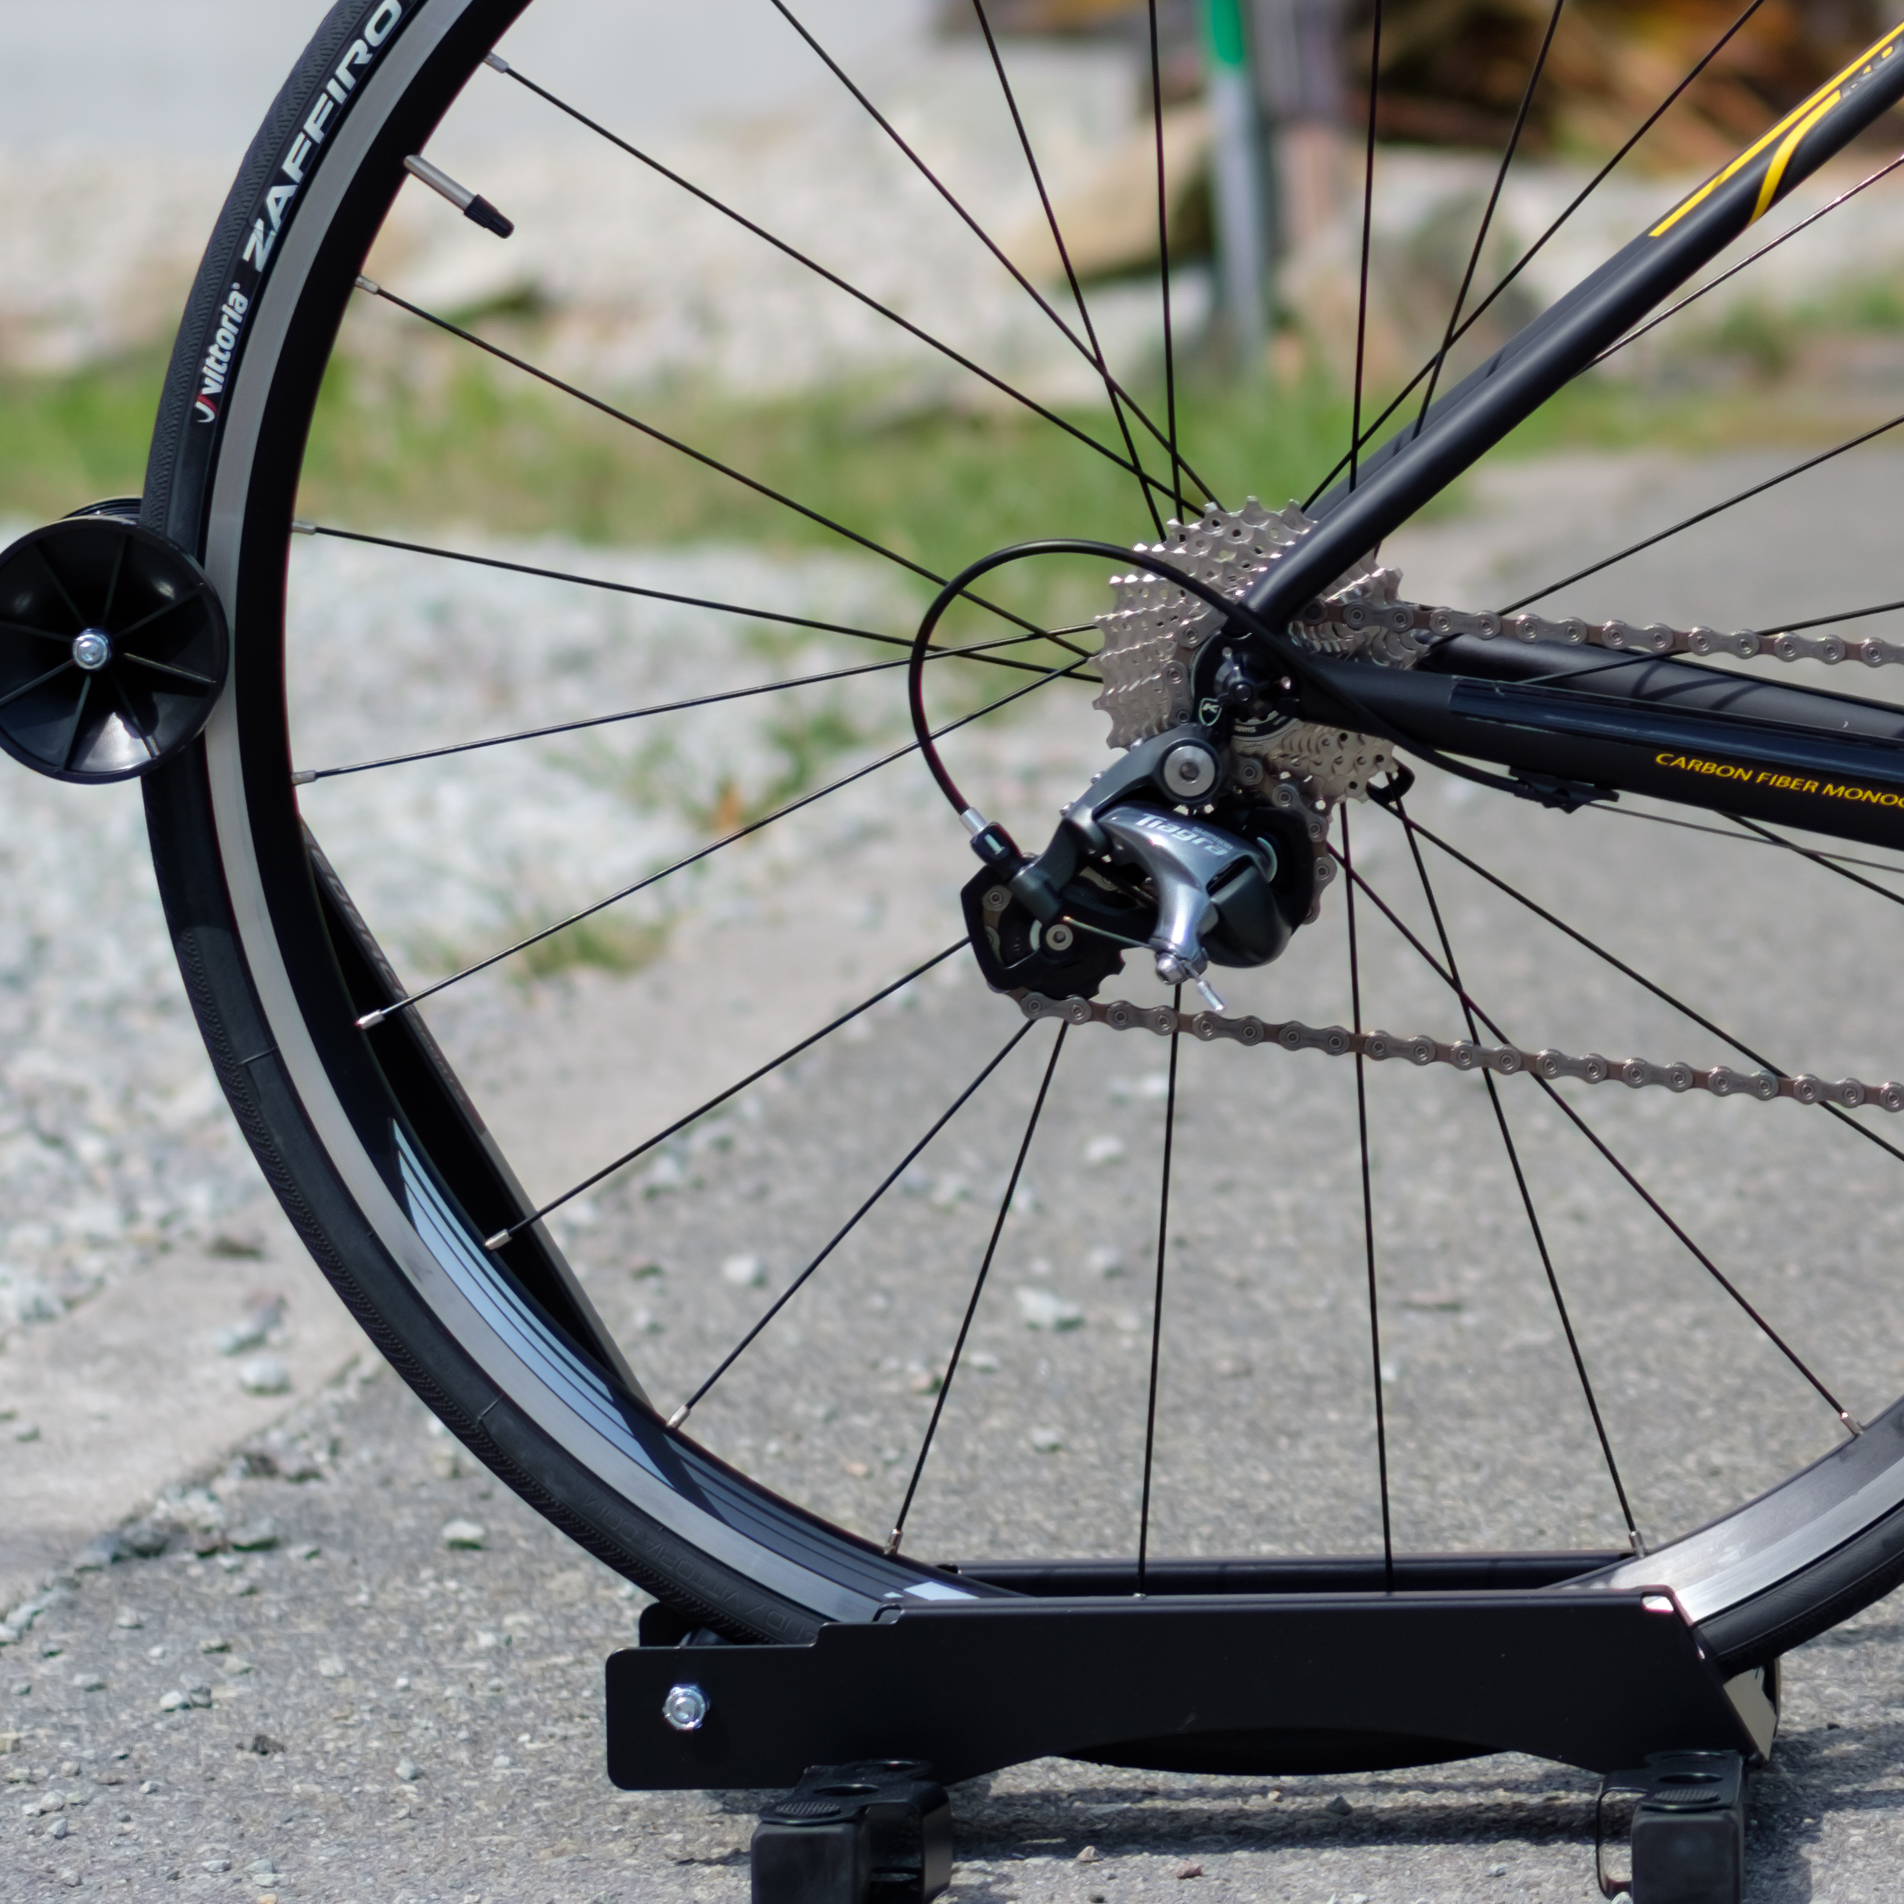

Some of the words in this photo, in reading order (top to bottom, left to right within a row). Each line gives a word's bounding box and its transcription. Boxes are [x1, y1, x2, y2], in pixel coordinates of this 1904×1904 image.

[1653, 752, 1754, 780] CARBON
[1756, 771, 1819, 794] FIBER
[1135, 813, 1230, 856] Tiagra
